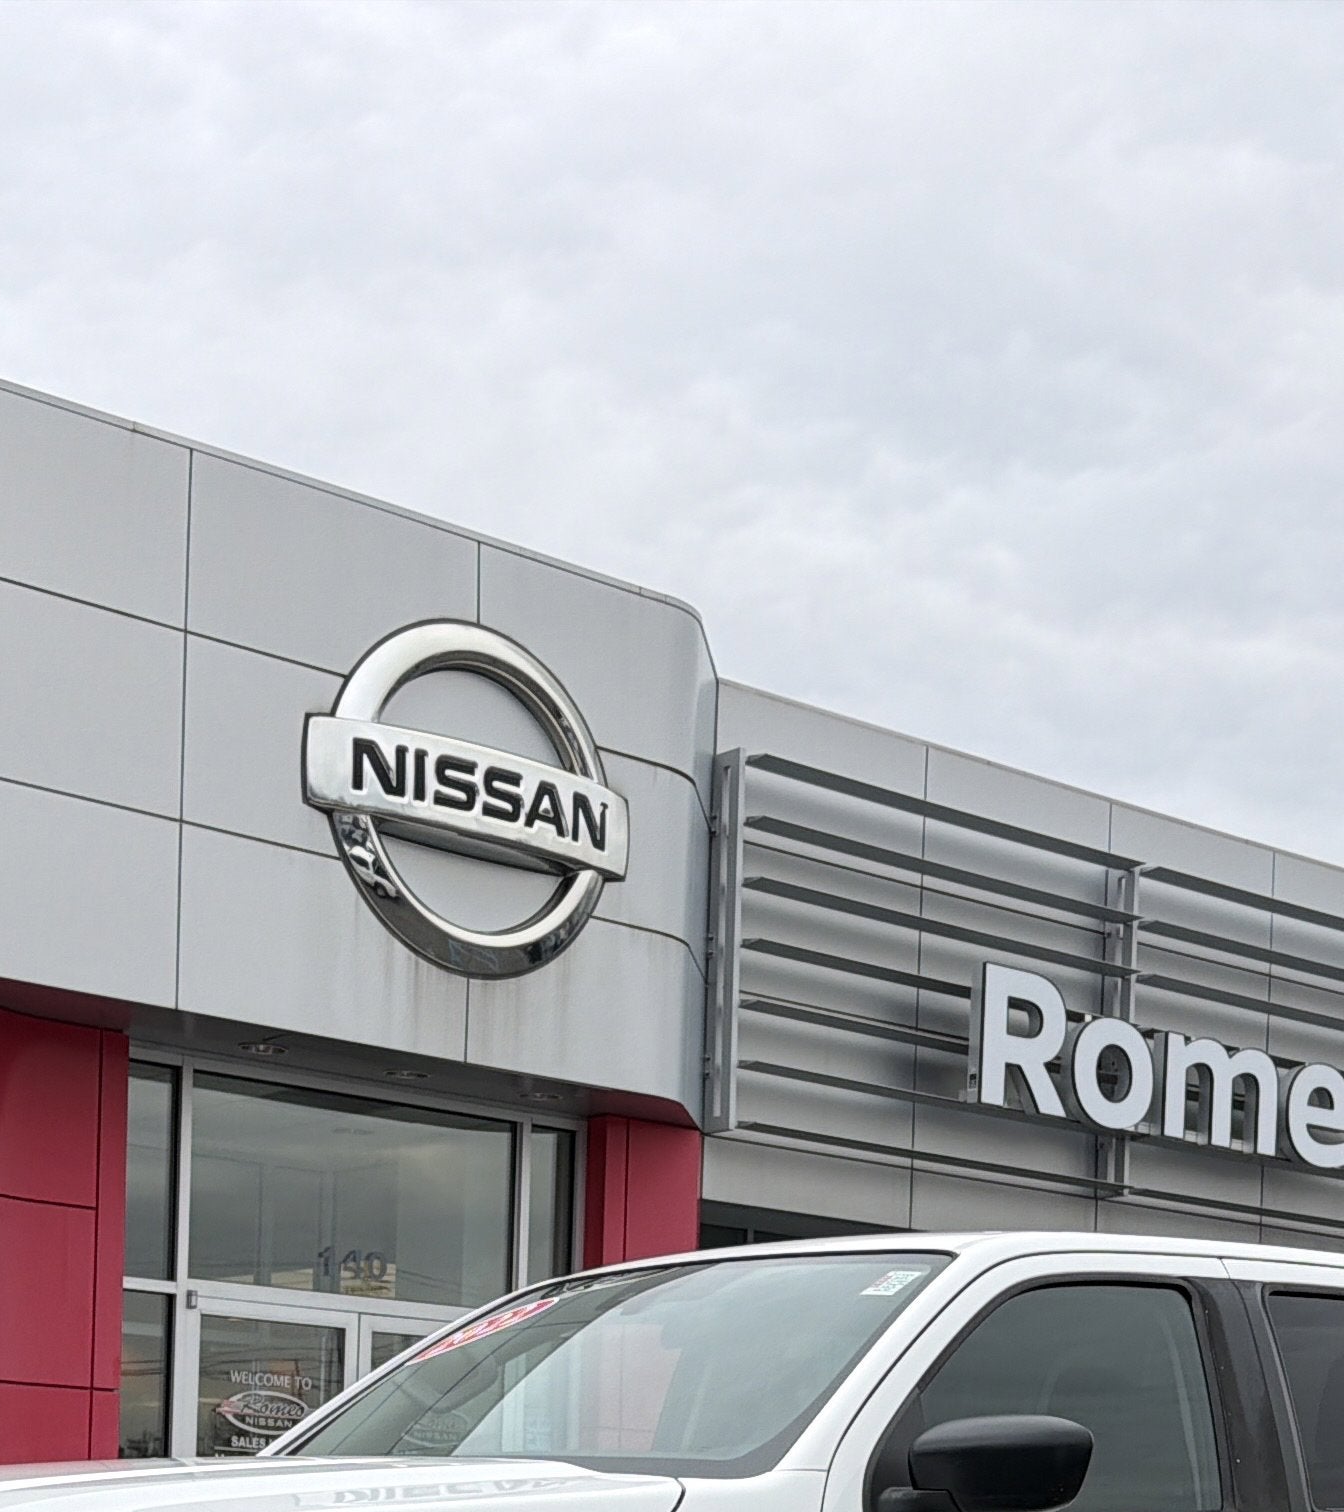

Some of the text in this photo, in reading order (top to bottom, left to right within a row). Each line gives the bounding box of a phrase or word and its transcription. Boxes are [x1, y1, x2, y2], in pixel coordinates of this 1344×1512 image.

[351, 737, 608, 852] NISSAN
[318, 1246, 387, 1281] 140
[230, 1370, 312, 1391] WELCOME TO
[241, 1393, 306, 1417] Romeo
[245, 1416, 293, 1428] NISSAN
[231, 1435, 266, 1448] SALES
